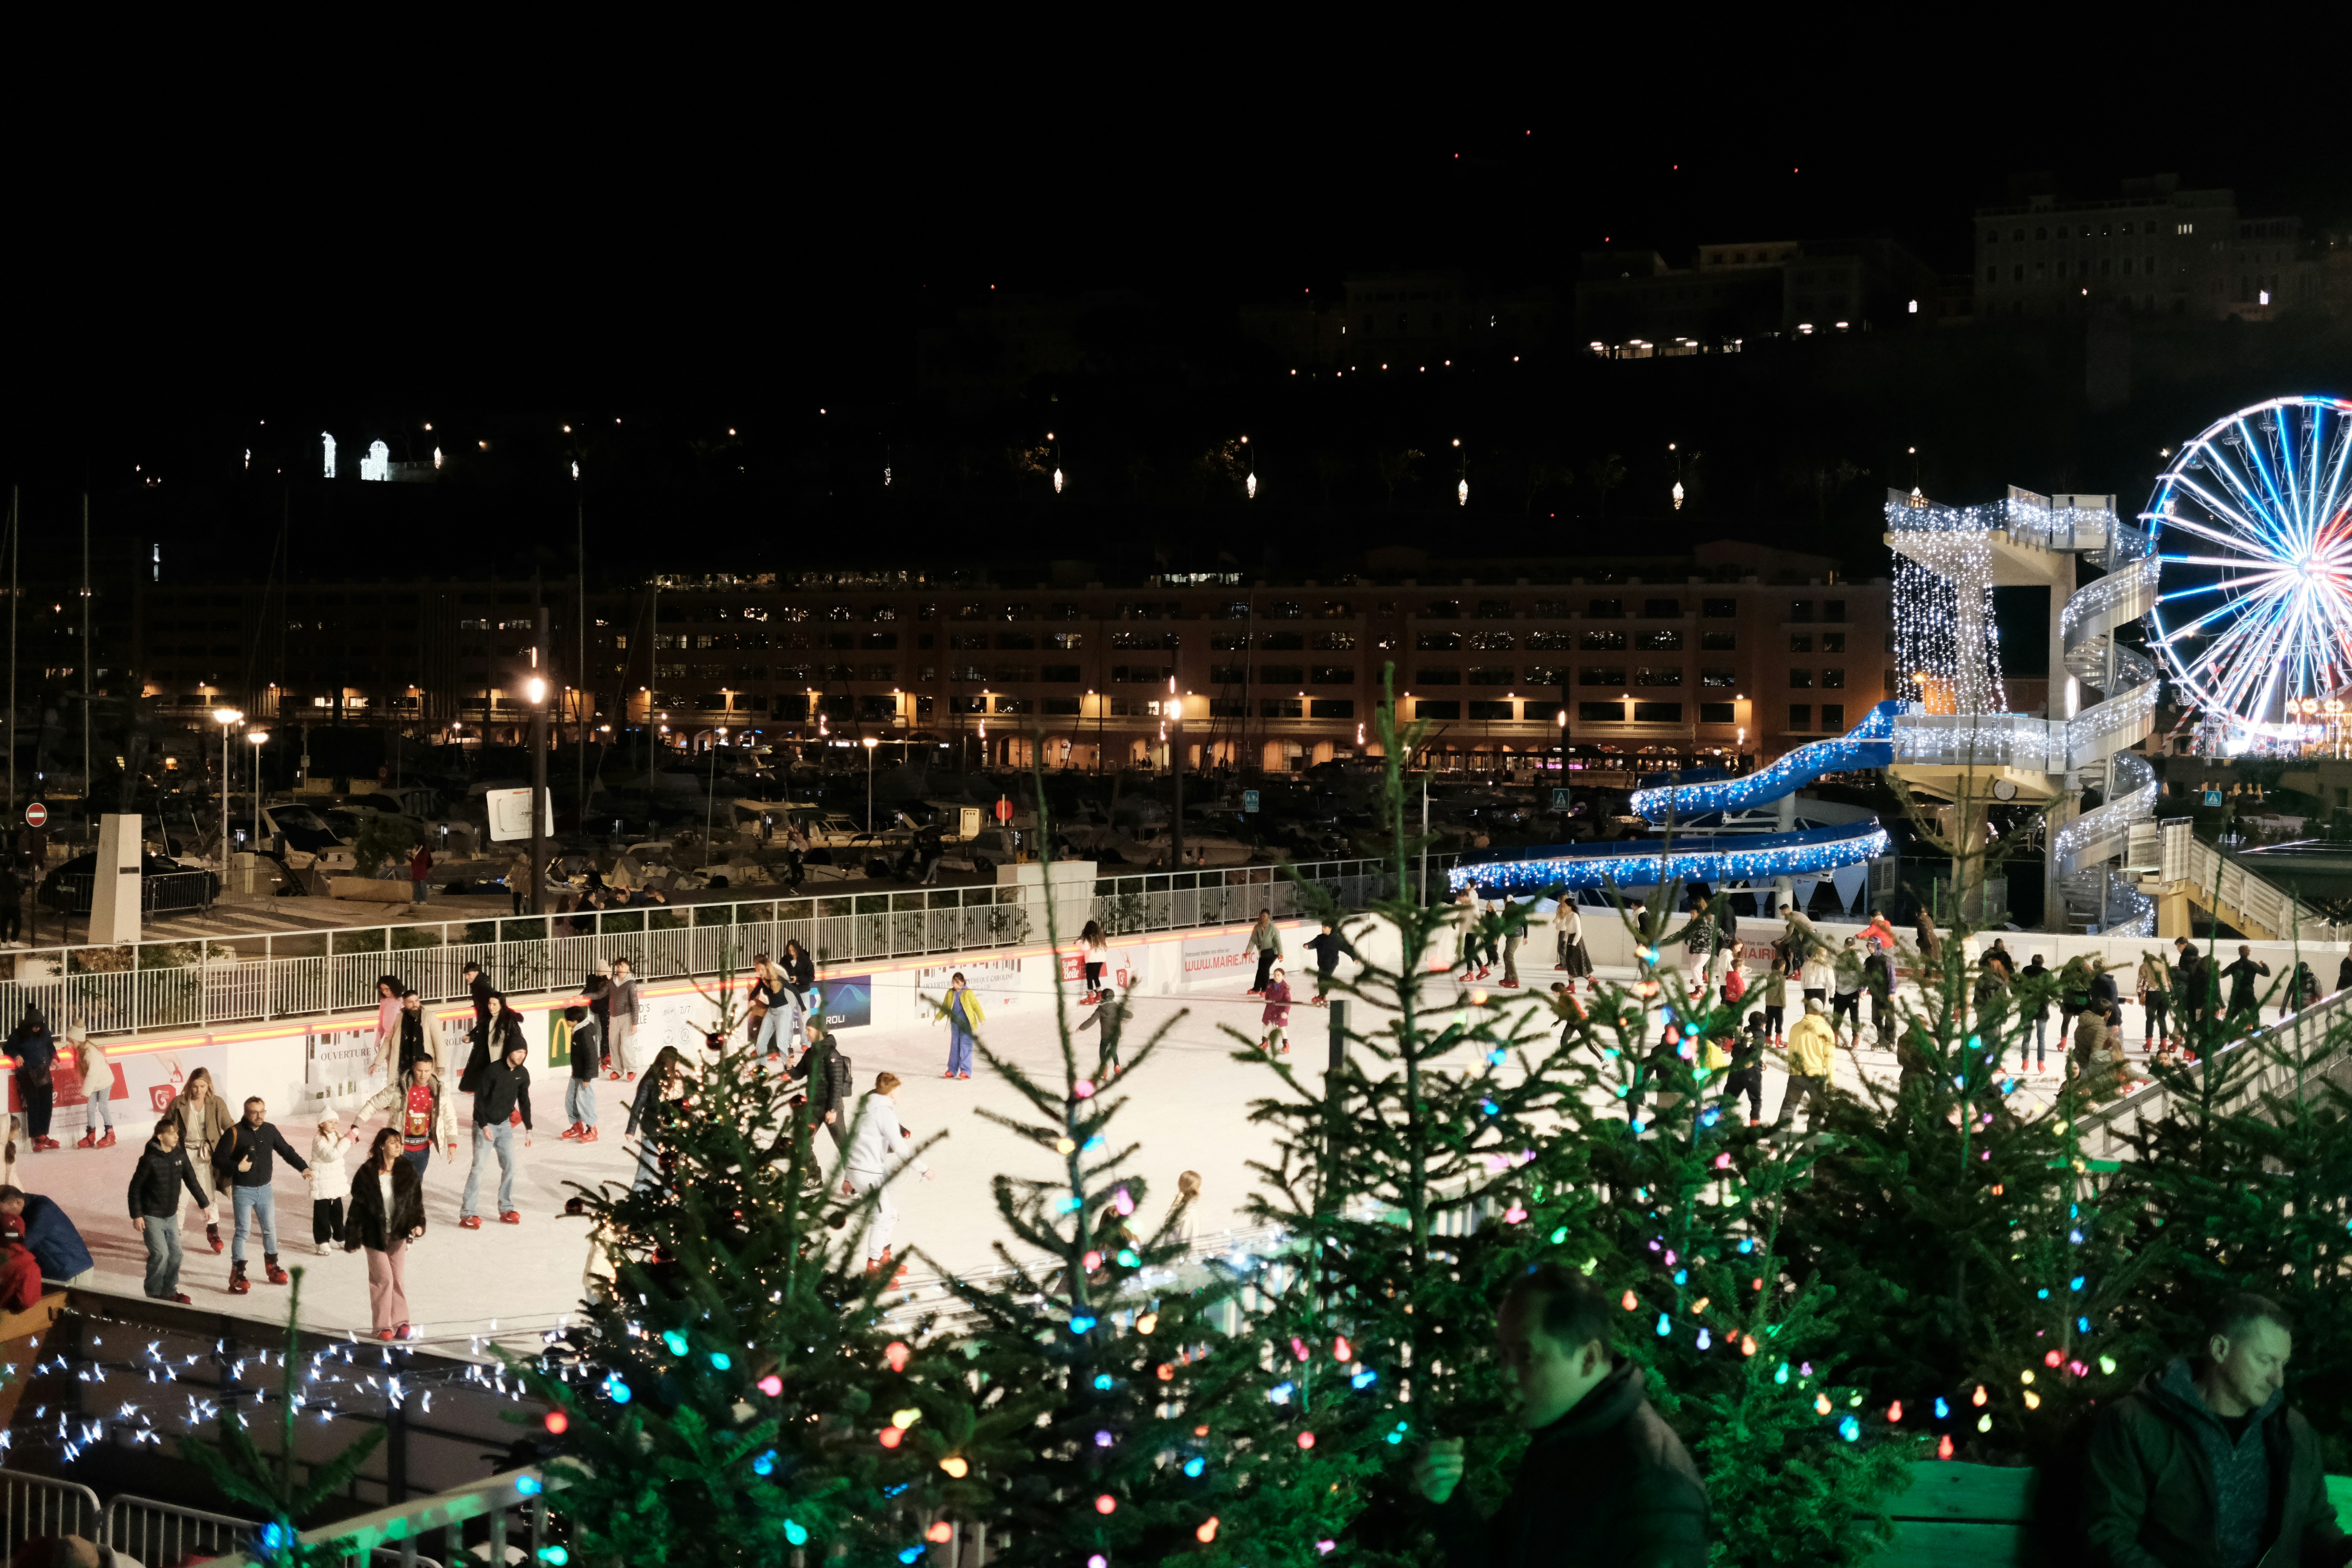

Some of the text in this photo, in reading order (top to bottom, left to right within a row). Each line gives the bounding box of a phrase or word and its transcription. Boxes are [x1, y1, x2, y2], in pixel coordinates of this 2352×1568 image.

[966, 976, 989, 985] ATHÈQUE
[990, 974, 1014, 982] CAROLINE
[826, 1015, 845, 1024] ROLI
[321, 1047, 371, 1061] OUVERTURE
